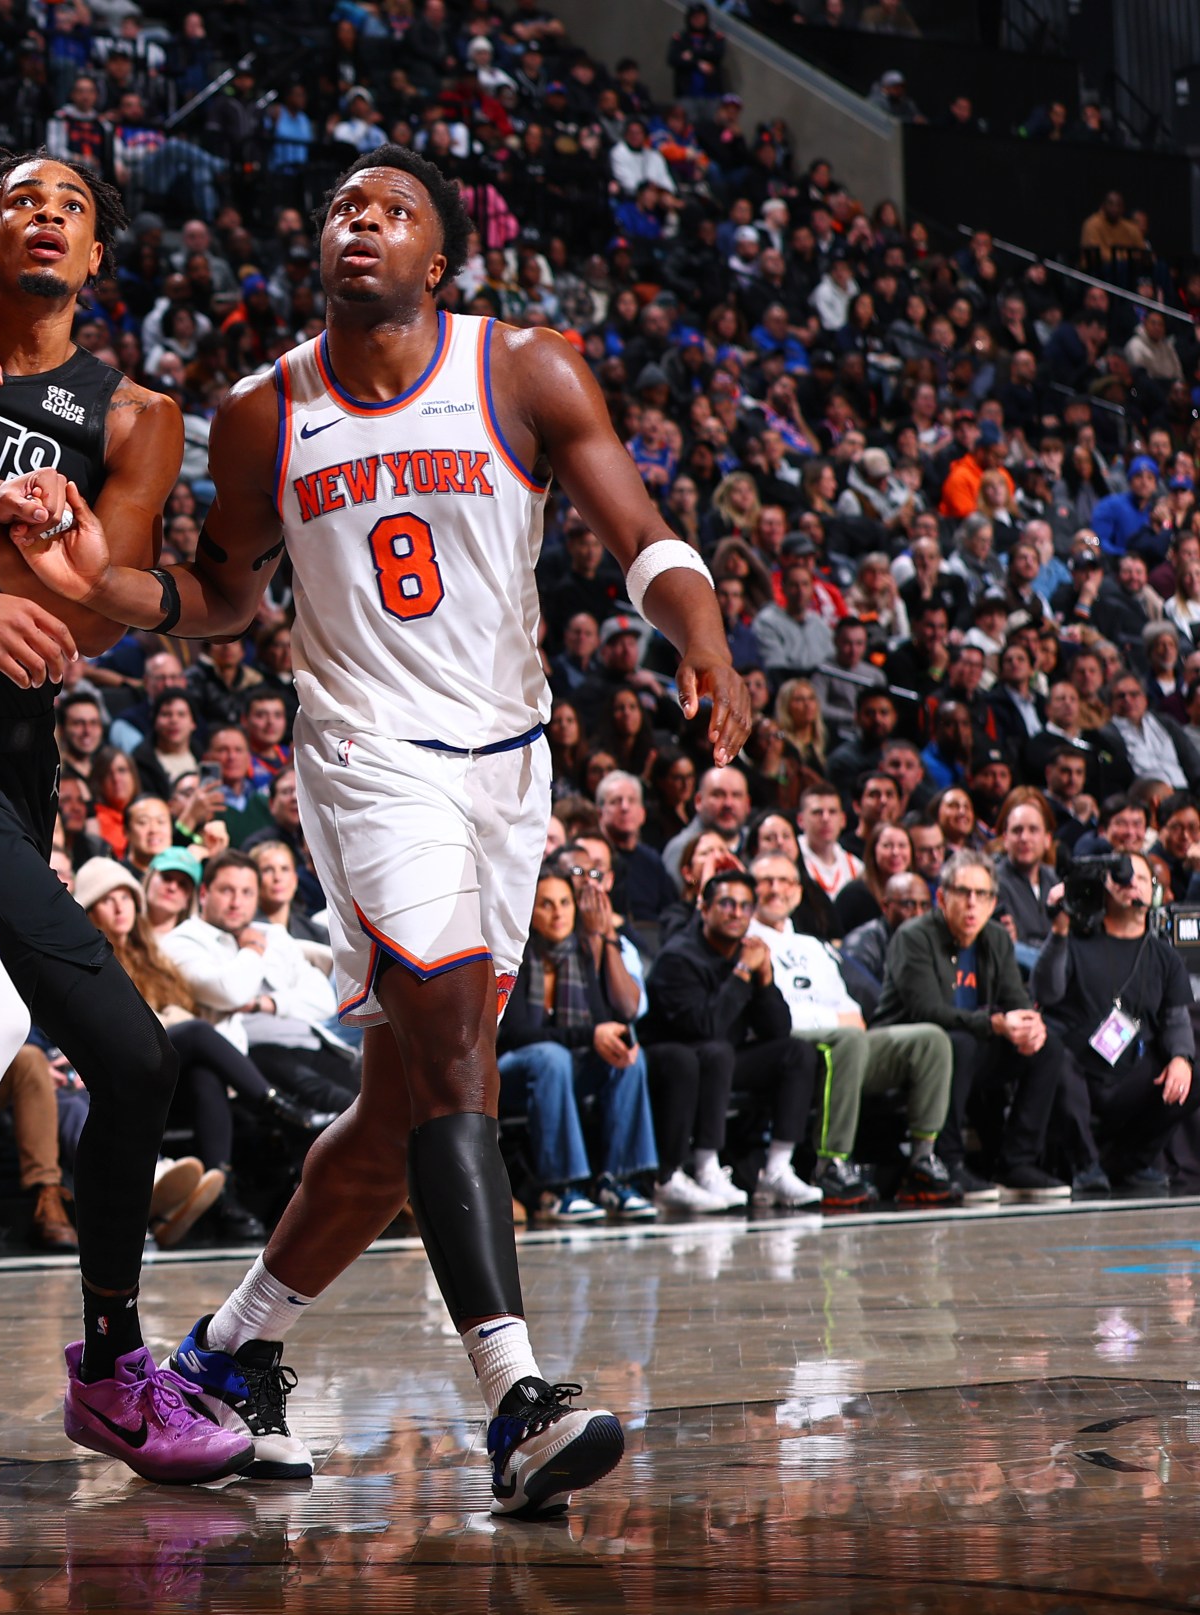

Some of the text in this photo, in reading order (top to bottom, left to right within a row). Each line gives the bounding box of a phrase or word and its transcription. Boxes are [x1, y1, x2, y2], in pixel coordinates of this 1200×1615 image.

[47, 385, 76, 401] GET
[47, 390, 86, 415] YOUR
[42, 399, 86, 426] GUIDE
[421, 402, 475, 415] abu dhabi
[293, 449, 494, 524] NEW YORK
[367, 511, 445, 622] 8
